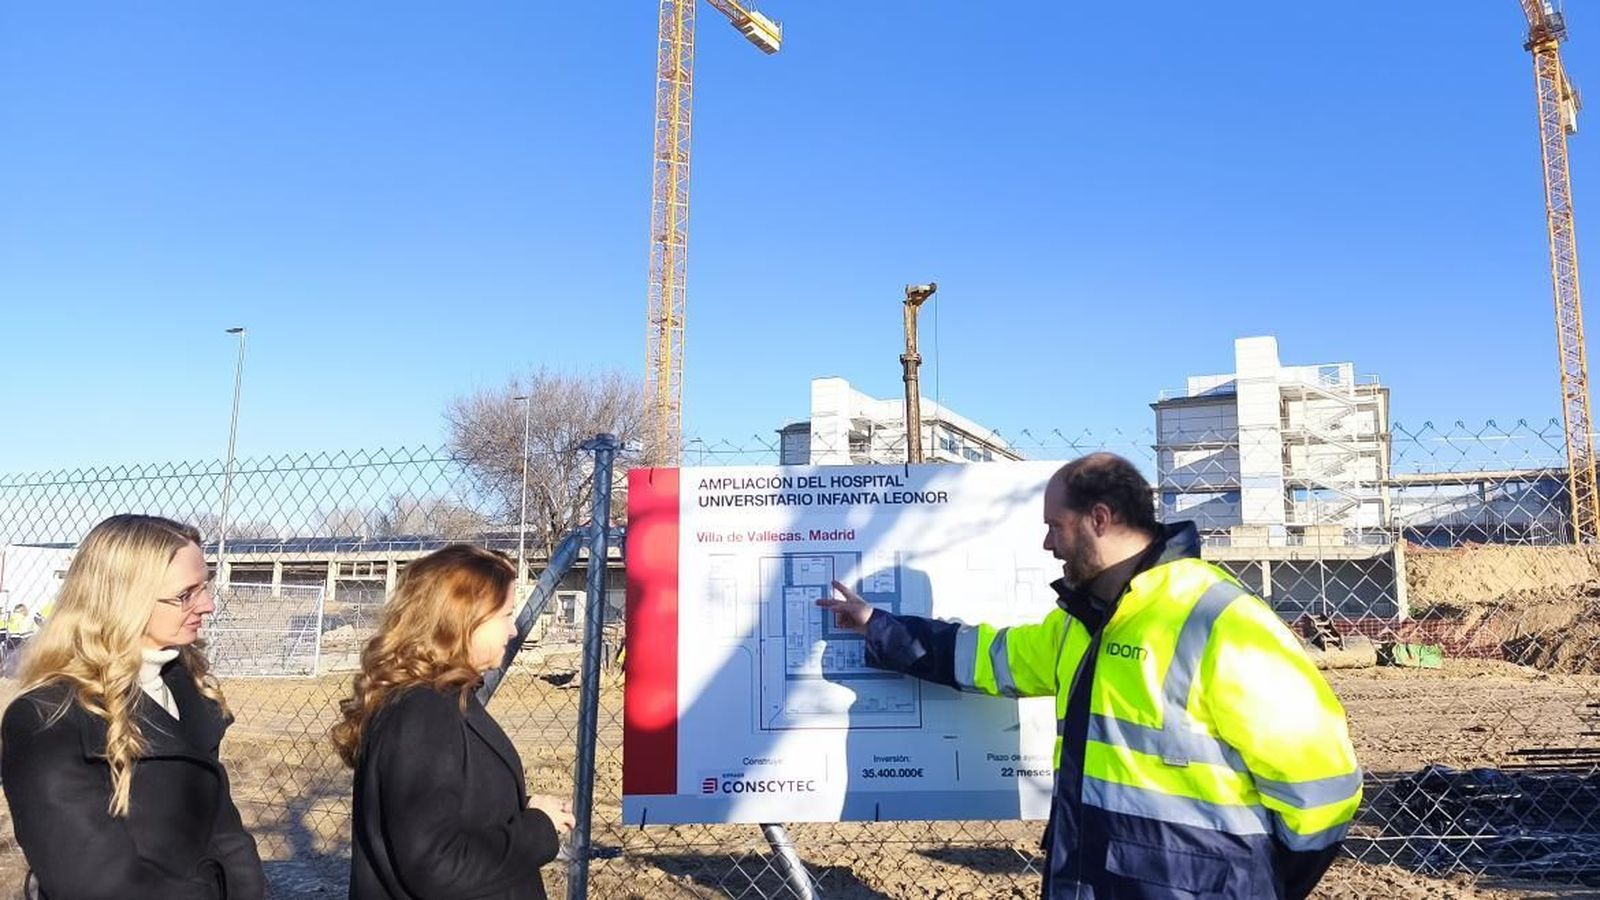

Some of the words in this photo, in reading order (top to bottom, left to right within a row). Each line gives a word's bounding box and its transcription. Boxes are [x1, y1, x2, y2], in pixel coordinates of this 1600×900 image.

[698, 475, 794, 491] AMPLIACIÓN
[797, 476, 827, 489] DEL
[830, 474, 904, 489] HOSPITAL
[698, 493, 811, 508] UNIVERSITARIO
[816, 492, 880, 506] INFANTA
[884, 491, 949, 505] LEONOR
[696, 531, 723, 543] Villa
[726, 531, 744, 542] de
[808, 528, 856, 541] Madrid
[1106, 642, 1148, 661] IDOM
[861, 767, 925, 779] 35.400.000€
[1001, 767, 1014, 777] 22
[1016, 768, 1052, 777] meses
[721, 780, 816, 794] CONSCYTEC
